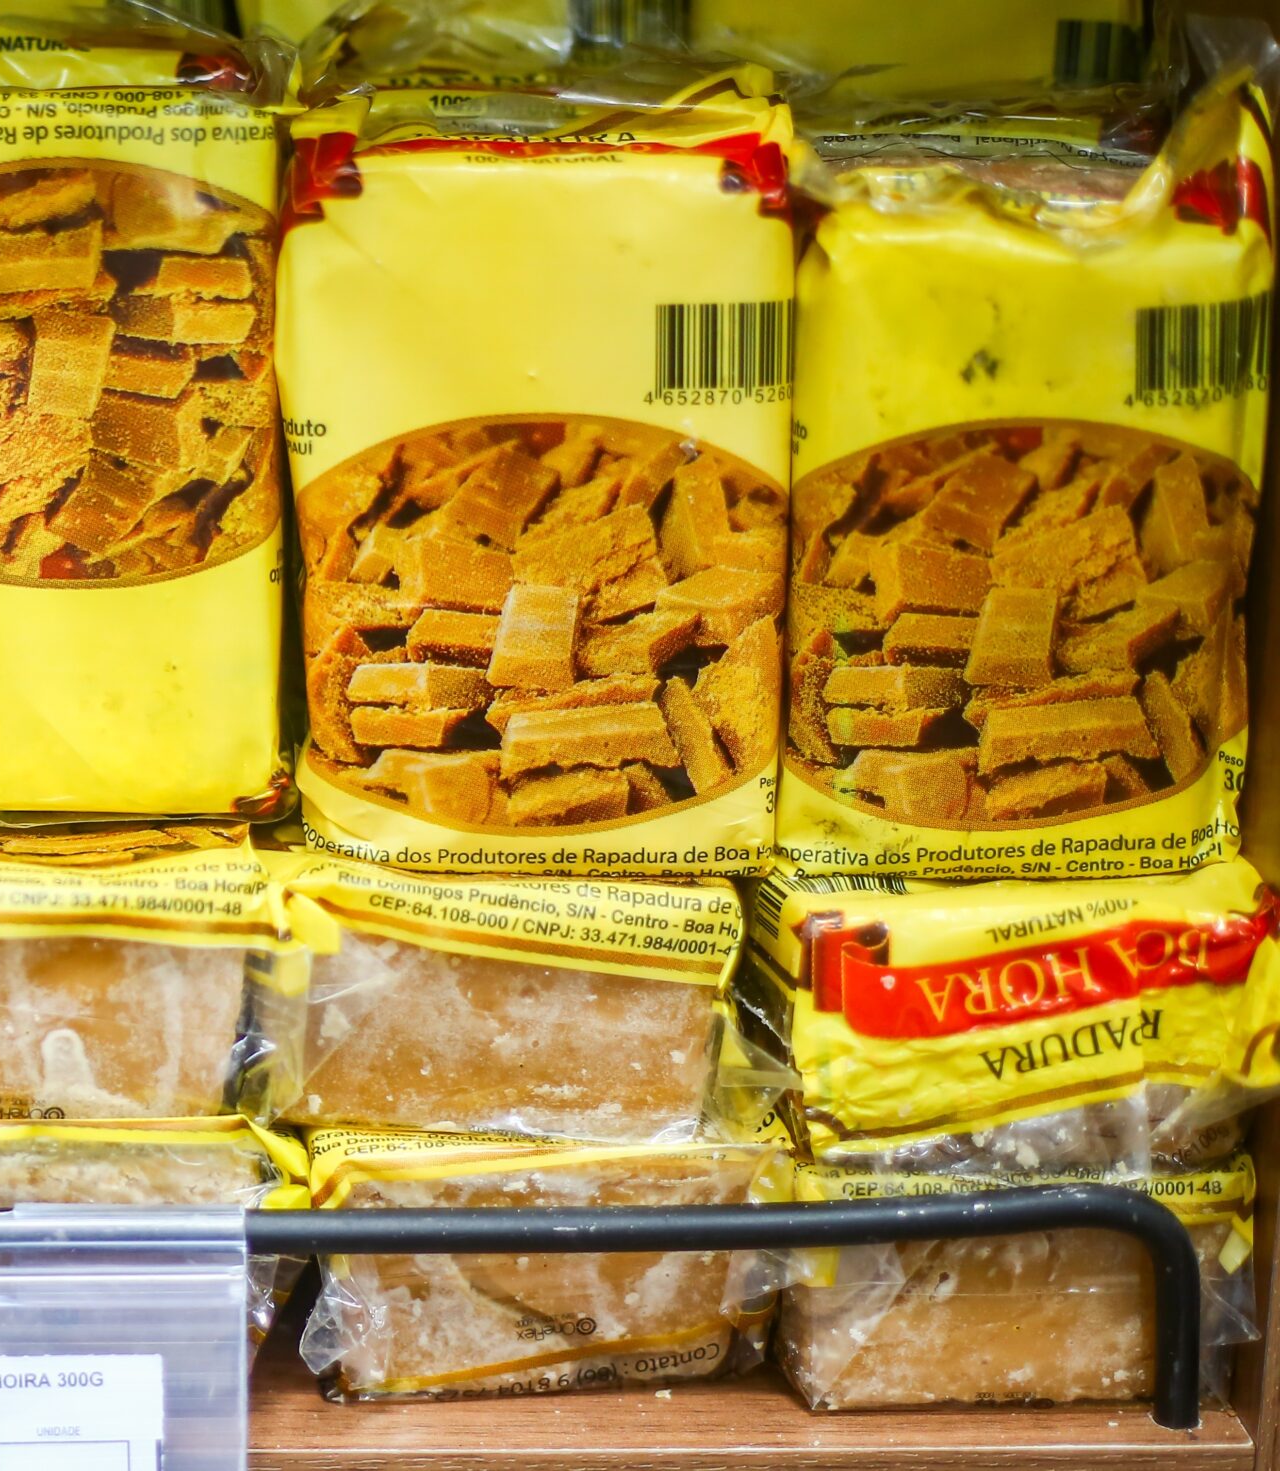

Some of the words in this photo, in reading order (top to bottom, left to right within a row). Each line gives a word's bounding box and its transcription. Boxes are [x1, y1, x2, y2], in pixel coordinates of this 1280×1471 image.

[26, 102, 57, 118] S/N
[62, 100, 158, 119] Prudêncio,
[22, 125, 49, 145] de
[54, 124, 165, 145] Produtores
[170, 127, 208, 147] dos
[643, 390, 655, 406] 4
[663, 389, 743, 406] 652870
[1123, 394, 1135, 409] 4
[1218, 750, 1245, 768] Peso
[874, 848, 911, 866] dos
[916, 843, 1026, 863] Produtores
[1030, 839, 1057, 858] de
[1061, 833, 1155, 857] Rapadura
[1161, 832, 1188, 850] de
[1191, 823, 1214, 847] Boa
[395, 846, 432, 864] dos
[437, 847, 546, 865] Produtores
[551, 847, 577, 864] de
[582, 848, 678, 868] Rapadura
[683, 846, 709, 864] de
[713, 845, 750, 863] Boa
[923, 864, 1016, 877] Prudêncio,
[1020, 862, 1052, 874] S/N
[1066, 857, 1125, 874] Centro
[1140, 856, 1175, 870] Boa
[174, 877, 209, 892] Boa
[70, 891, 243, 917] 33.471.984/0001-48
[377, 879, 464, 901] Domingos
[468, 887, 561, 918] Prudêncio,
[565, 902, 597, 920] S/N
[611, 910, 669, 930] Centro
[682, 919, 715, 935] Boa
[575, 880, 602, 899] de
[607, 885, 703, 913] Rapadura
[707, 896, 732, 915] de
[368, 892, 509, 930] CEP:64.108-000
[523, 918, 576, 940] CNPJ:
[984, 906, 1085, 944] NATURAL
[914, 945, 1099, 1024] HORA
[516, 1318, 577, 1341] OneFlex
[634, 1342, 720, 1372] Contato
[57, 1371, 105, 1388] 300G
[557, 1372, 570, 1390] 9
